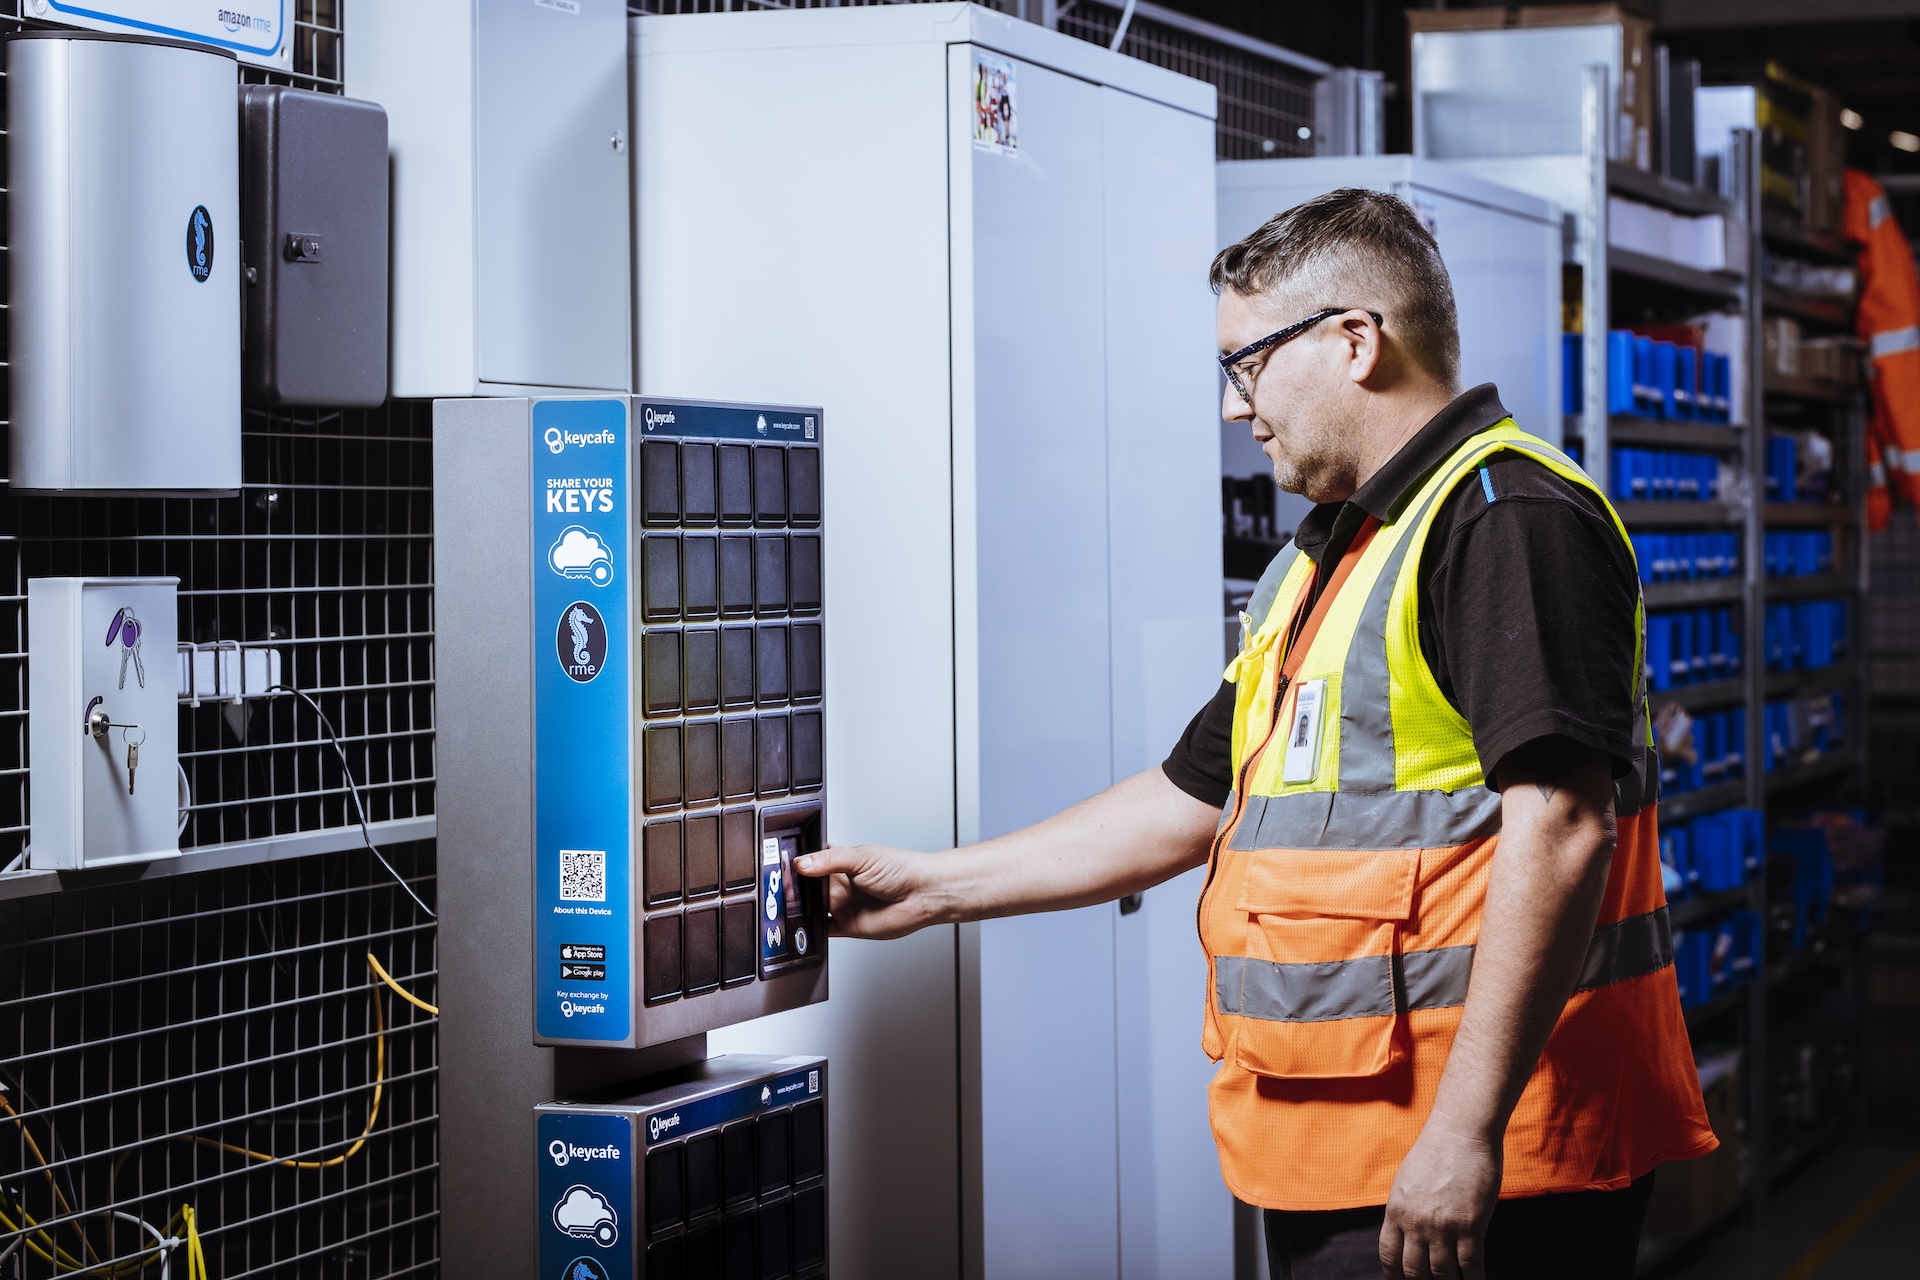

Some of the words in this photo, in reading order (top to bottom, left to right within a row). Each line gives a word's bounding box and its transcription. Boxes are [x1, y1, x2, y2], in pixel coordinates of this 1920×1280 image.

[218, 9, 251, 28] amazon
[253, 17, 271, 33] rme
[193, 265, 208, 276] rme
[653, 410, 675, 426] keycafe
[564, 429, 615, 448] keycafe
[547, 479, 581, 488] SHARE
[583, 478, 613, 488] YOUR
[547, 489, 614, 513] KEYS
[569, 664, 595, 675] rme
[553, 906, 574, 914] About
[575, 907, 588, 915] this
[589, 908, 612, 916] Device
[573, 950, 586, 959] App
[573, 969, 592, 978] Google
[557, 990, 569, 998] Key
[569, 991, 599, 1000] exchange
[600, 992, 608, 1000] by
[573, 1003, 605, 1015] keycafe
[659, 1112, 680, 1131] keycafe
[569, 1142, 620, 1162] keycafe
